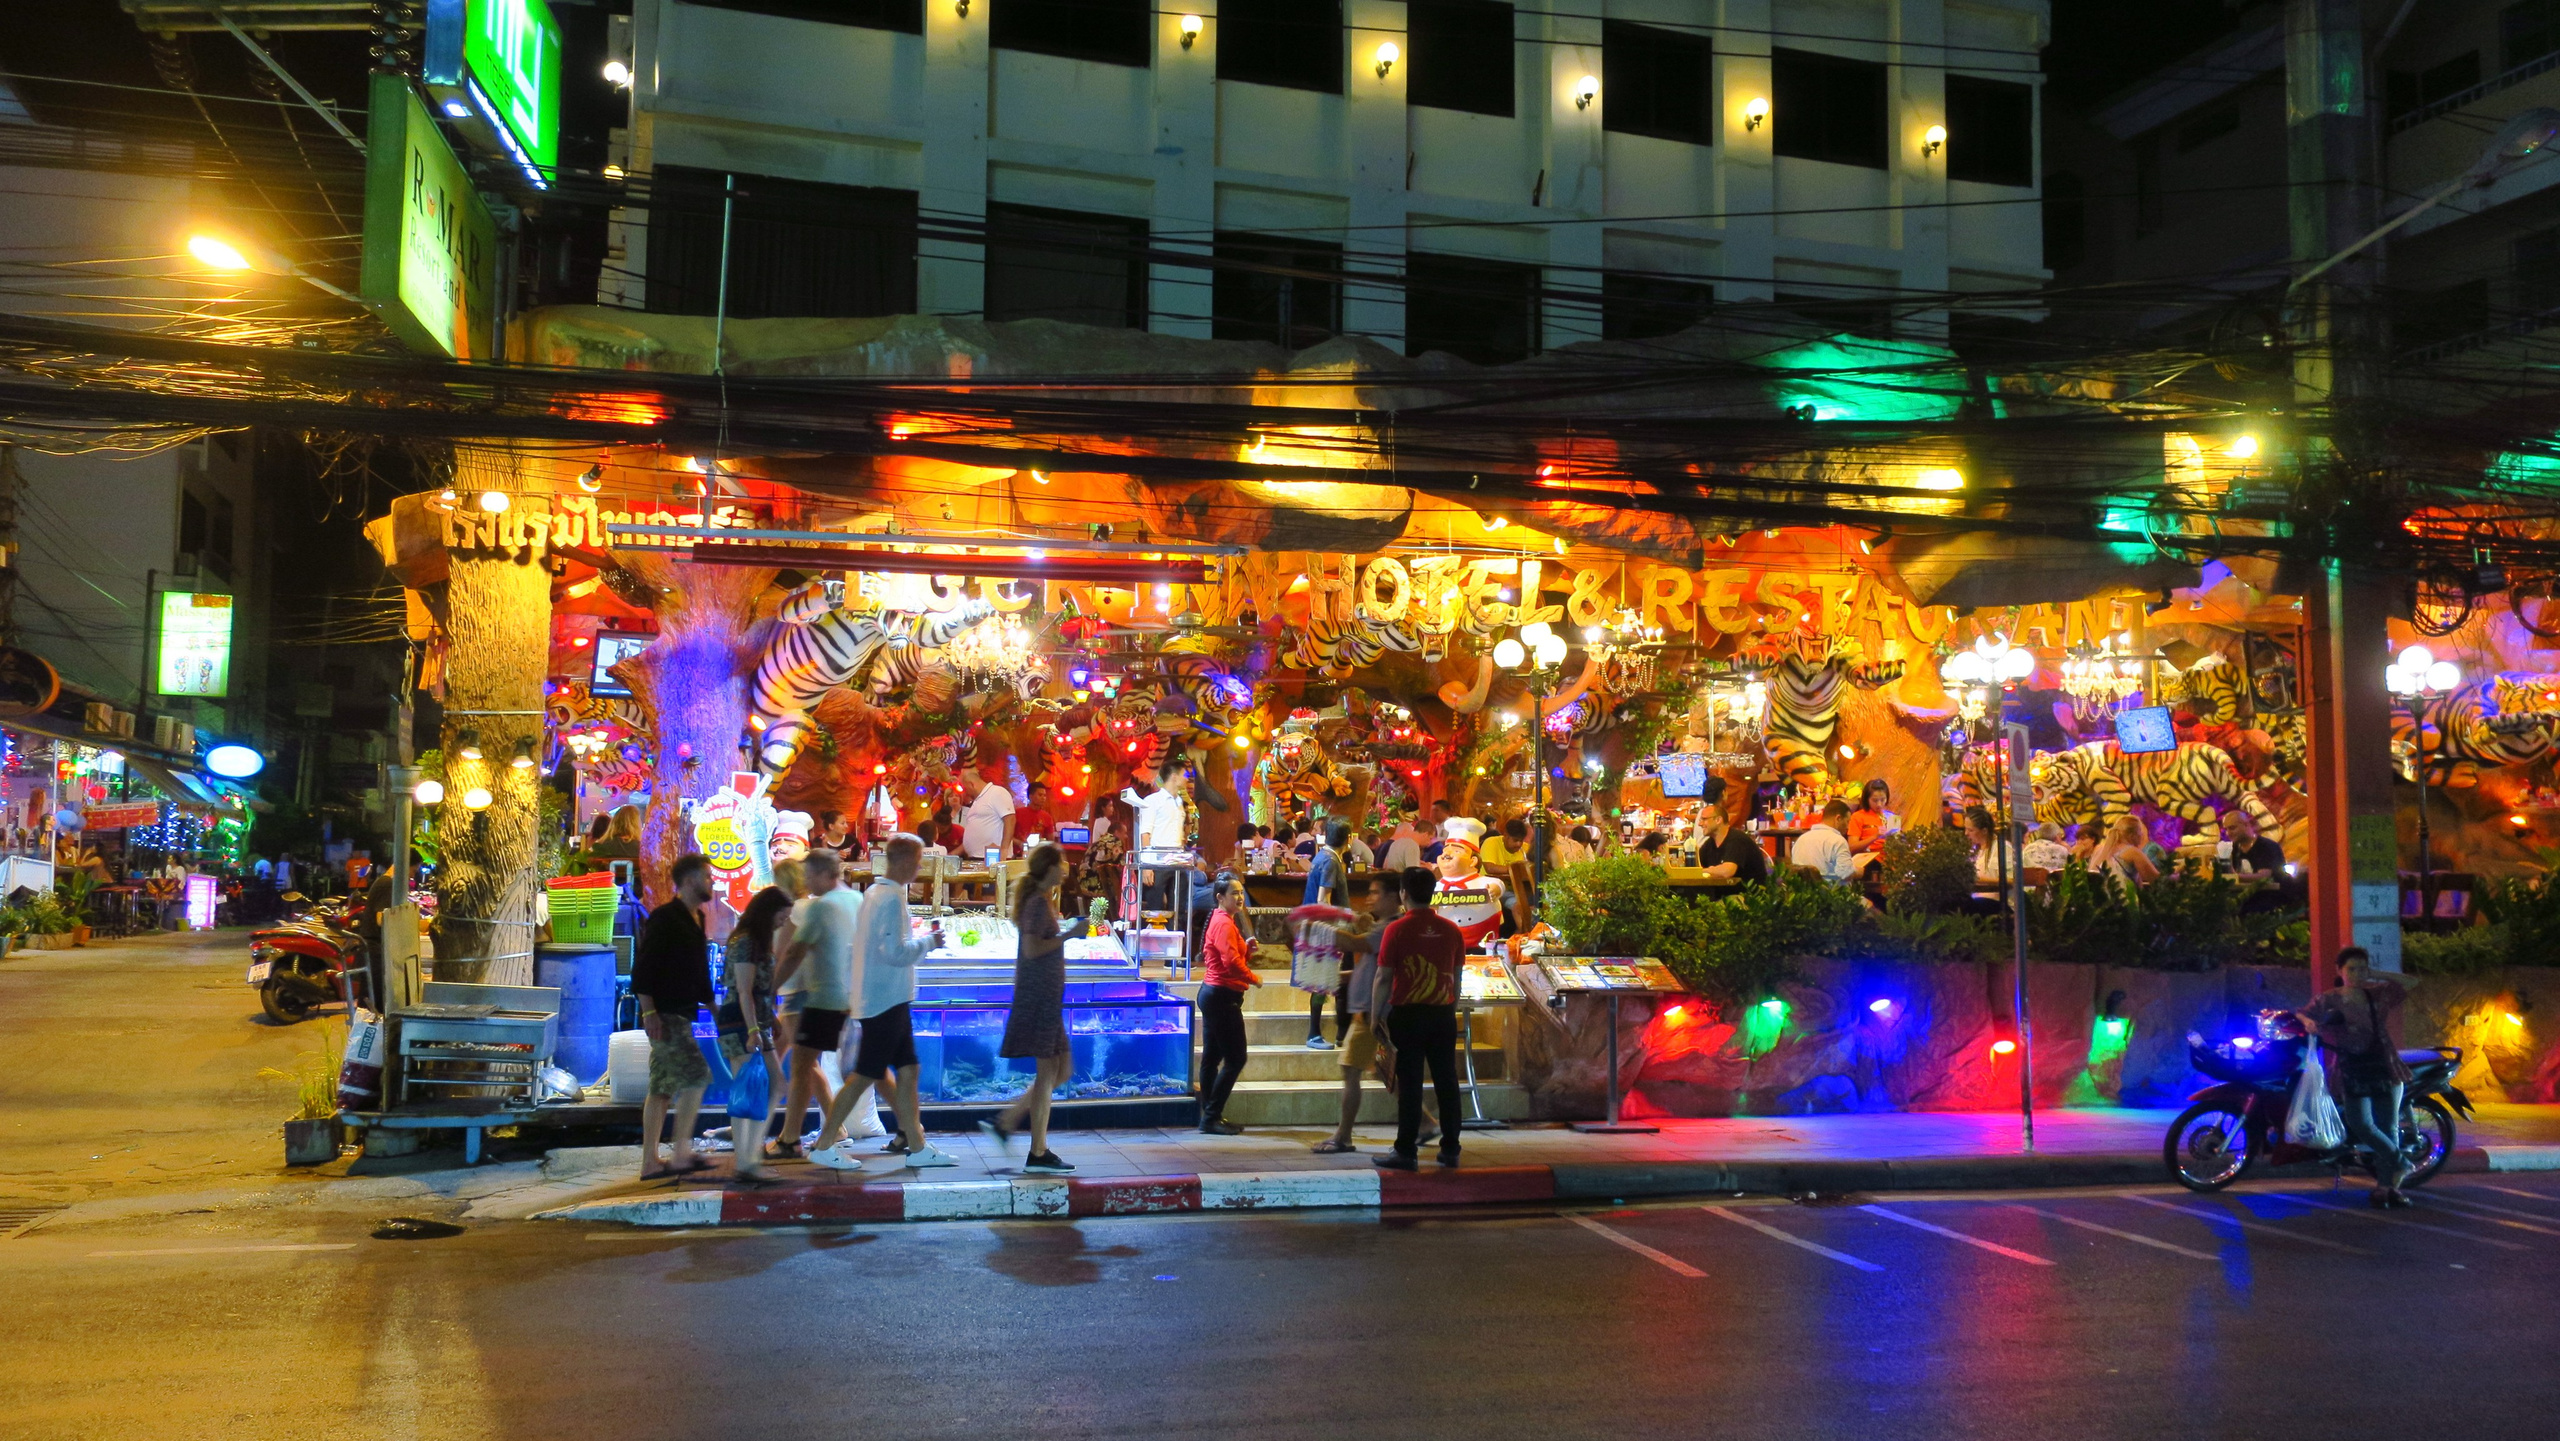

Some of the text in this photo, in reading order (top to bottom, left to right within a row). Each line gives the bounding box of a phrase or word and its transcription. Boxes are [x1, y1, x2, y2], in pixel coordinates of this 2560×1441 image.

[409, 216, 441, 286] Resort
[442, 272, 462, 311] and
[1305, 552, 1564, 627] HOTEL
[1567, 568, 1625, 628] &
[701, 825, 730, 833] PHUKET
[709, 841, 746, 861] 999
[1430, 891, 1486, 905] Welcome
